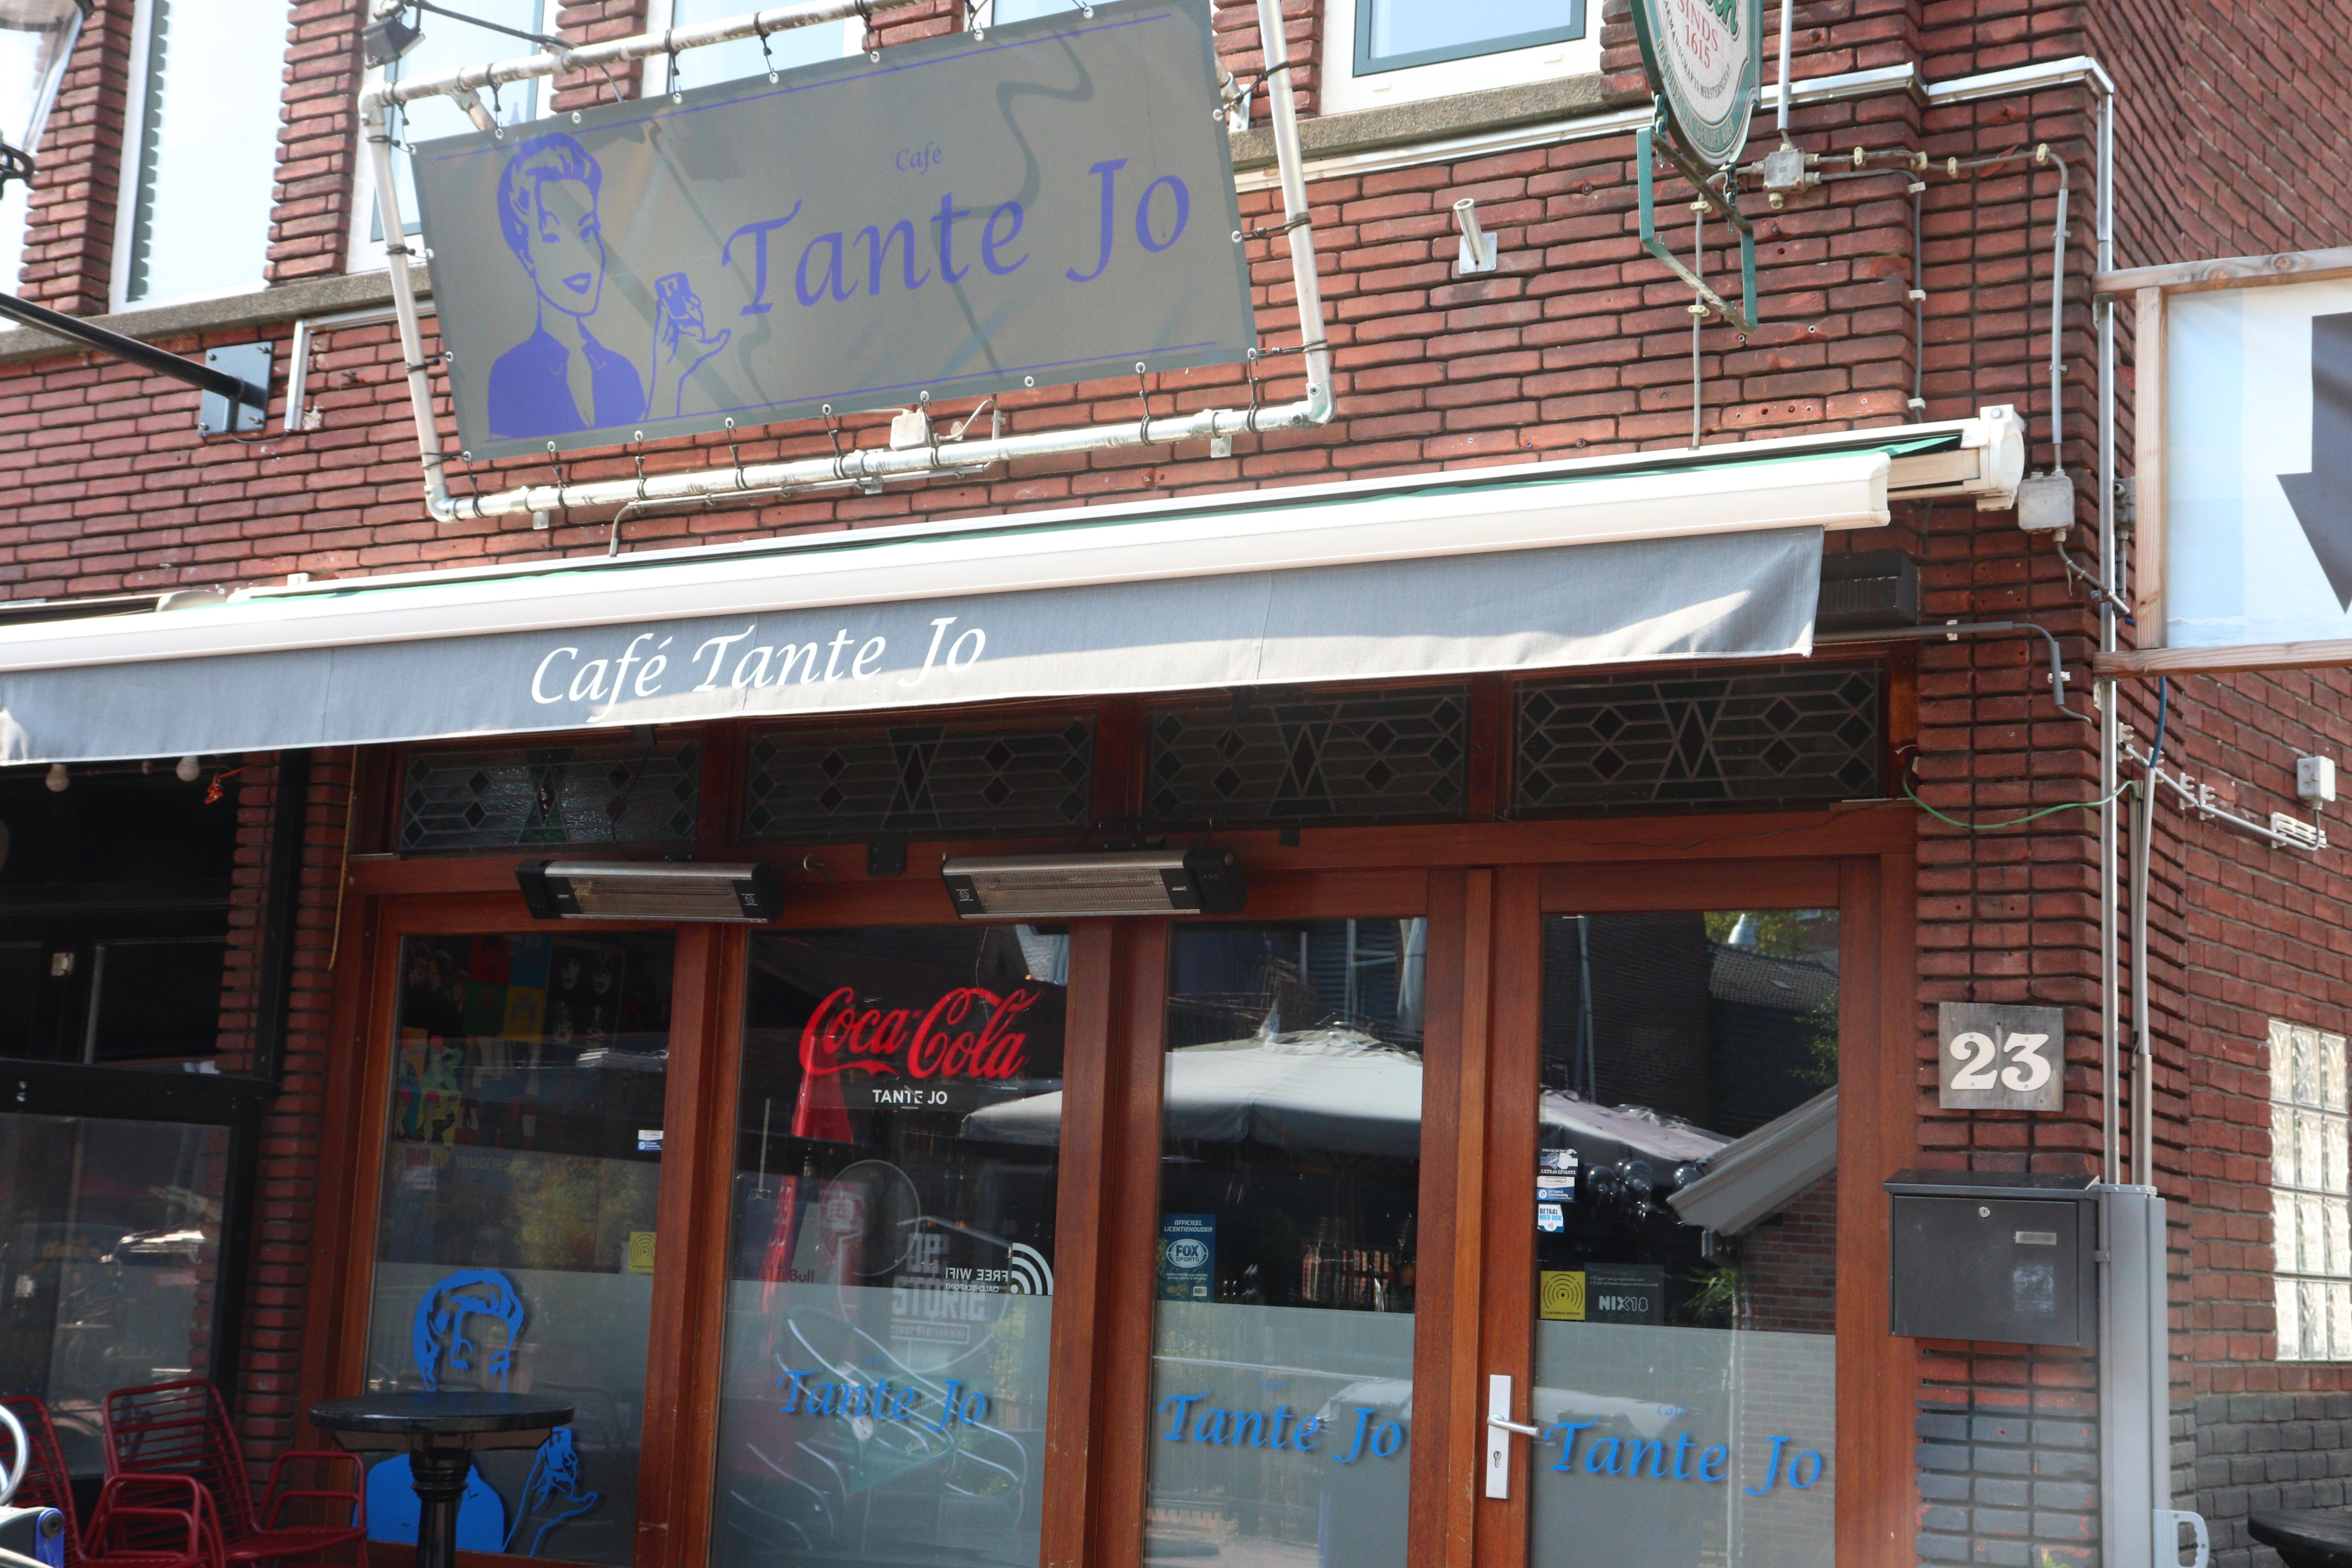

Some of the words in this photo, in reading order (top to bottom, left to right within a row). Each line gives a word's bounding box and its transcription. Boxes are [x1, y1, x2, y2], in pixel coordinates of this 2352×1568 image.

[1663, 0, 1694, 82] AKMANSCHAP
[1694, 77, 1699, 92] IS
[1678, 0, 1718, 51] SINDS
[1686, 24, 1710, 68] 1615
[895, 141, 942, 173] Café
[721, 192, 1030, 316] Tante
[1066, 158, 1190, 282] Jo
[531, 632, 673, 723] Café
[691, 624, 886, 692] Tante
[897, 616, 986, 688] Jo
[799, 986, 1046, 1079] Coca-Cola
[1949, 1031, 2052, 1092] 23
[872, 1089, 923, 1104] TANTE
[927, 1091, 948, 1105] JO
[1176, 1245, 1199, 1256] FOX
[1599, 1295, 1649, 1312] NIX18
[776, 1366, 915, 1420] Tante
[926, 1379, 985, 1431] Jo
[1159, 1390, 1319, 1451] Tante
[1333, 1408, 1401, 1463] Jo
[1544, 1417, 1727, 1482] Tante
[1745, 1436, 1822, 1495] Jo
